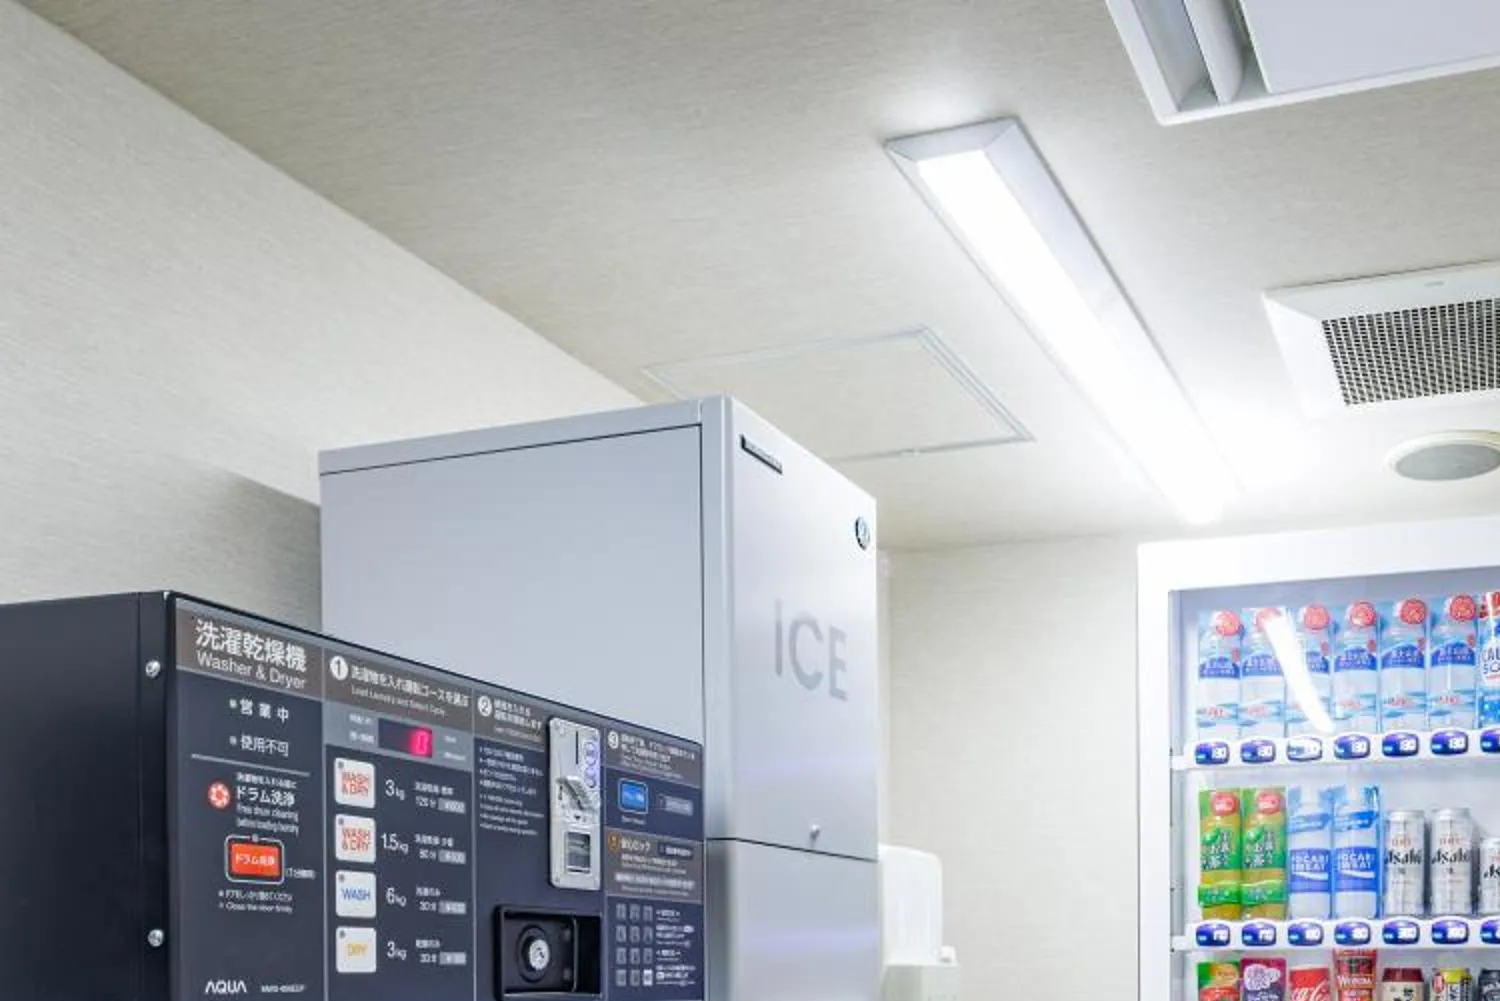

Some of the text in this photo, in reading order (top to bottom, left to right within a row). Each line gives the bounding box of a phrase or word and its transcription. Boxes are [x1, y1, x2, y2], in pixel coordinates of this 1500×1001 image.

[195, 618, 307, 673] 洗濯乾燥機
[774, 600, 848, 701] ICE
[196, 650, 307, 690] Washer & Dryer
[239, 735, 290, 758] 使用不可
[236, 785, 296, 807] ドラム洗浄
[1384, 849, 1422, 865] Asahi
[1432, 847, 1468, 864] Asahi
[342, 886, 371, 902] WASH
[204, 978, 248, 995] AQUA
